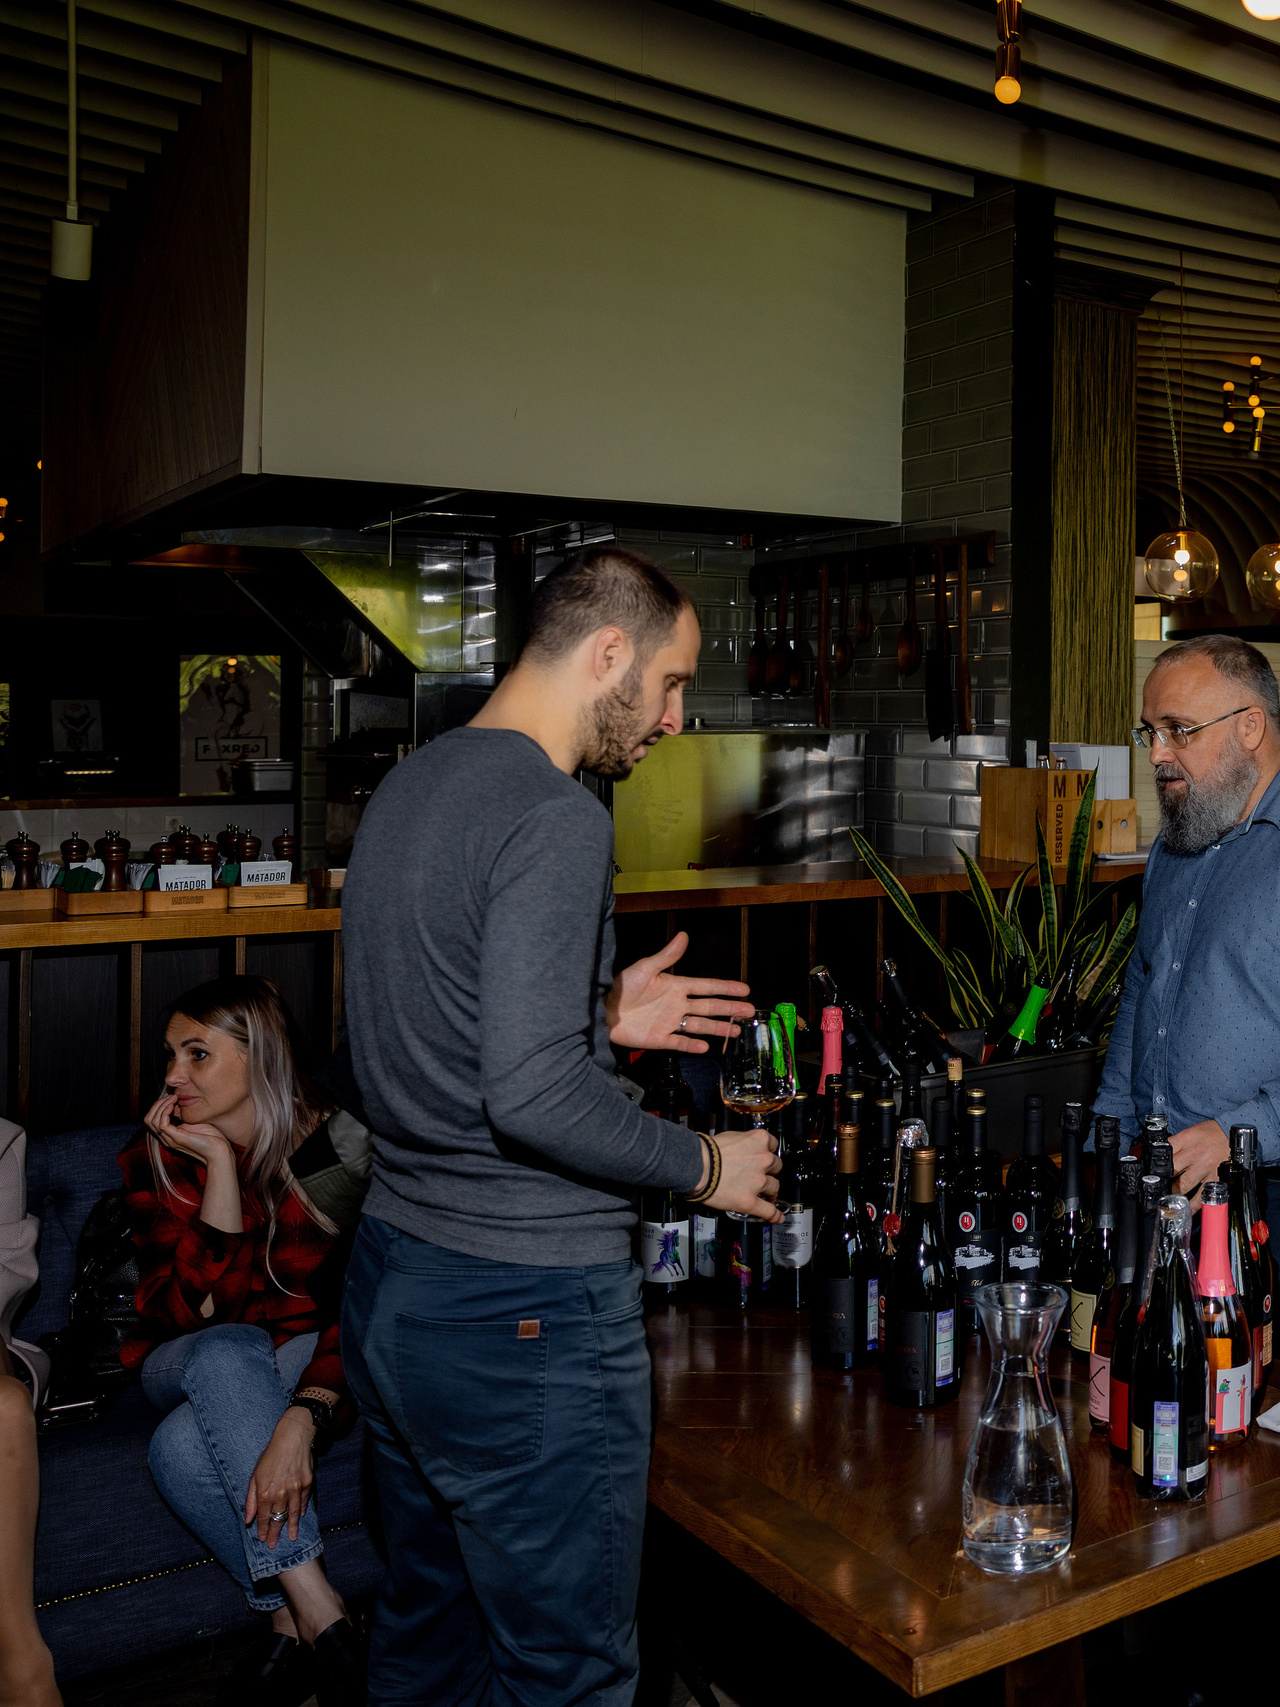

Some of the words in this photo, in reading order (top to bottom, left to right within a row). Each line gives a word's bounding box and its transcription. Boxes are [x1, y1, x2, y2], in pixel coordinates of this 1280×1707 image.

[1053, 775, 1066, 798] M
[1055, 804, 1063, 863] RESERVED
[165, 880, 206, 891] MATADOR
[247, 872, 286, 883] MATADOR
